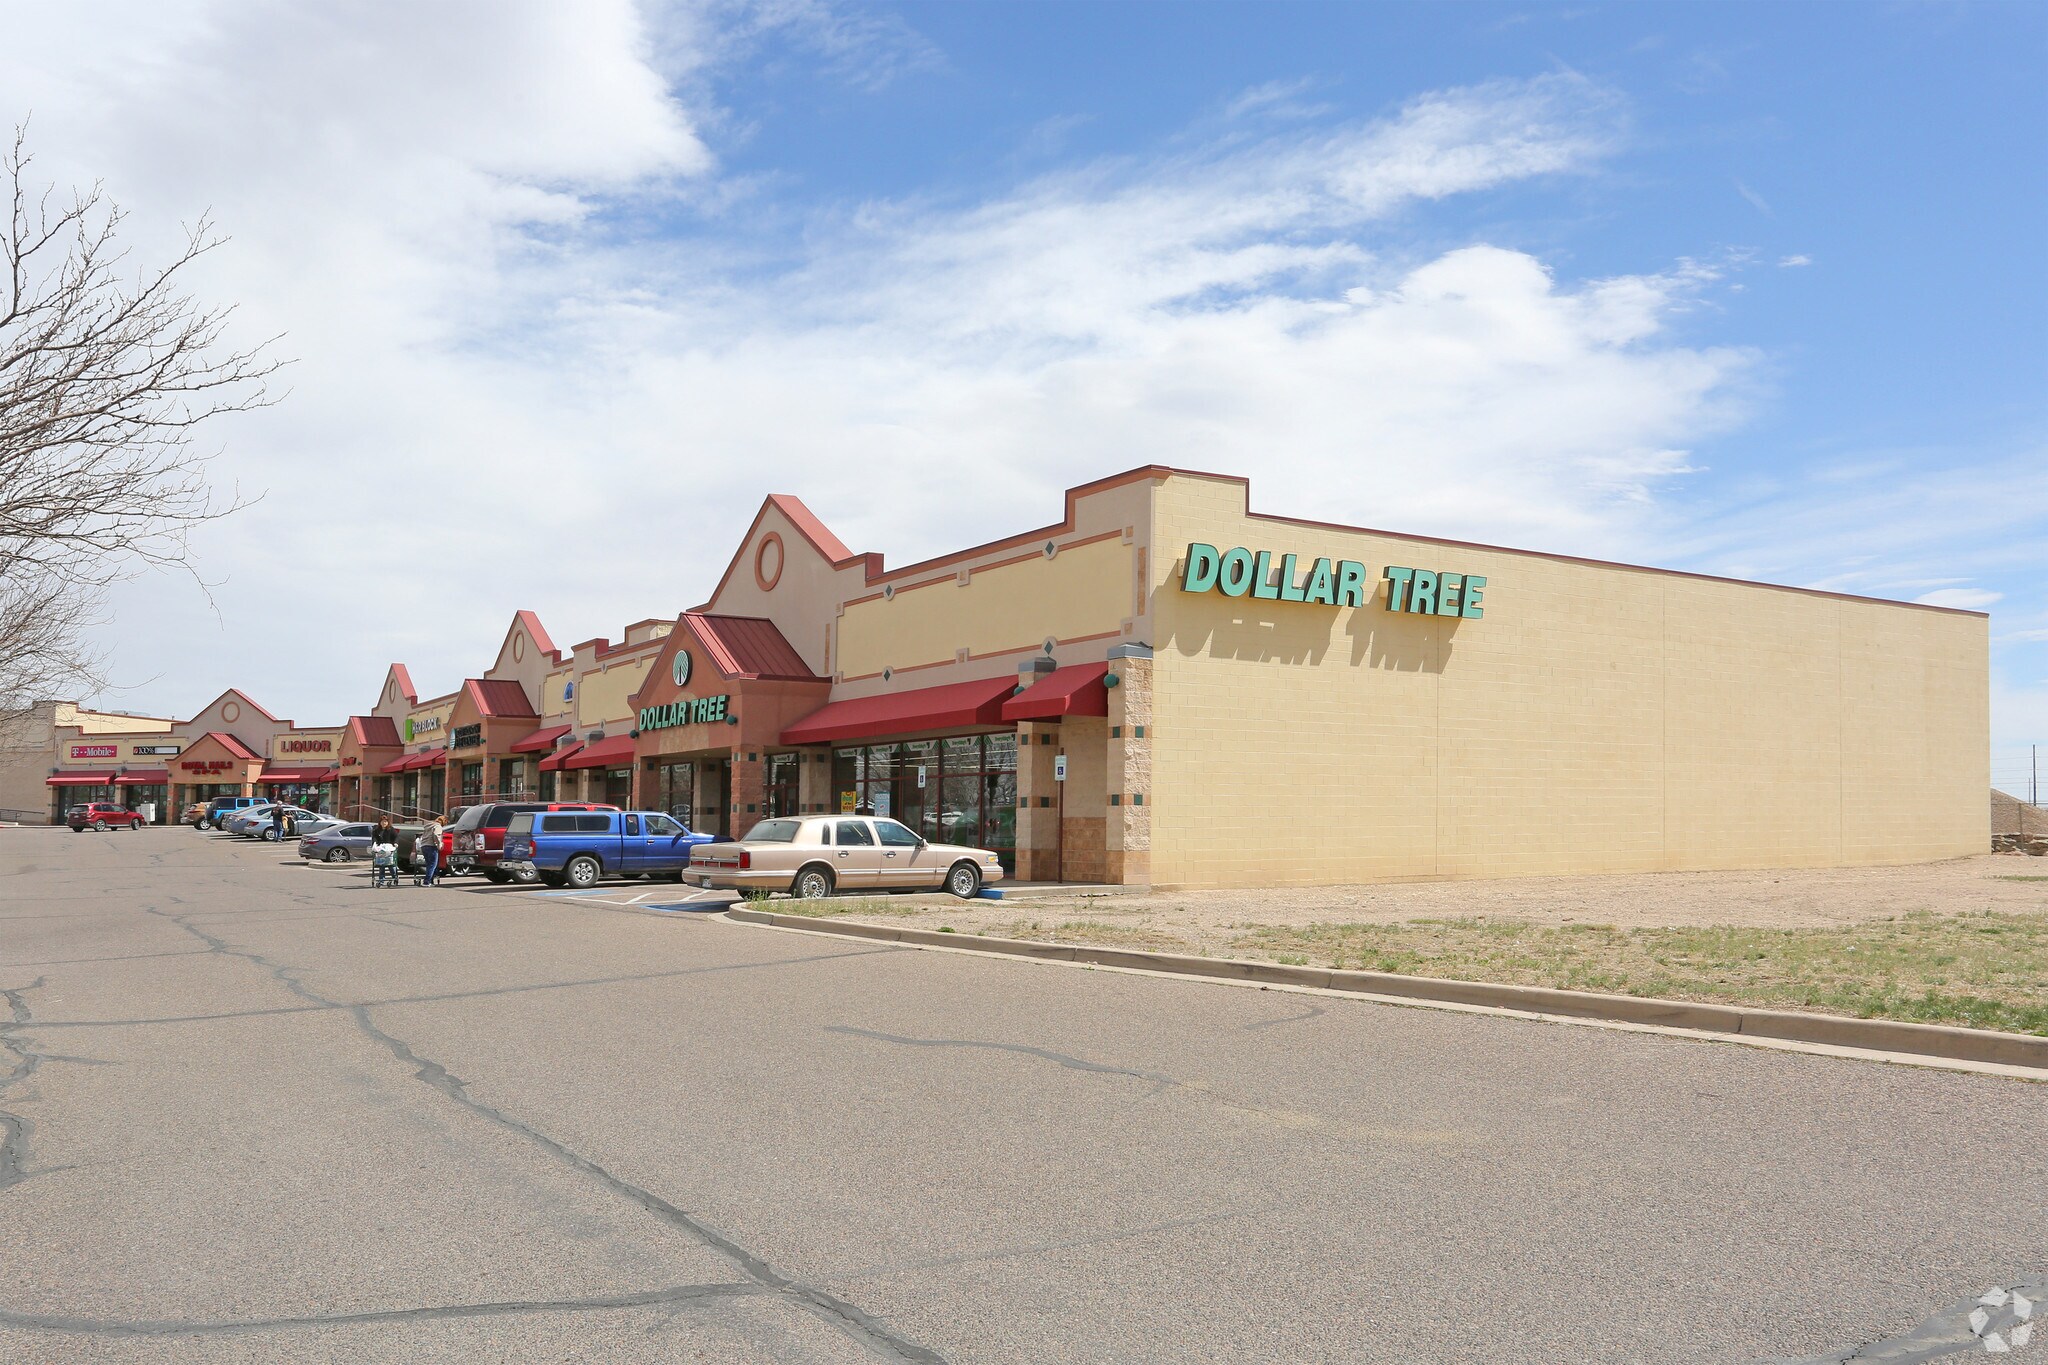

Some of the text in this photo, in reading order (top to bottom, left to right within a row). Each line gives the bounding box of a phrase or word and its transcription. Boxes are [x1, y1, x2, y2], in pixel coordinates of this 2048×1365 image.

[1181, 543, 1487, 619] DOLLAR TREE
[422, 717, 440, 733] BLOCK
[639, 695, 729, 731] DOLLAR TREE
[281, 740, 331, 753] LIQUOR
